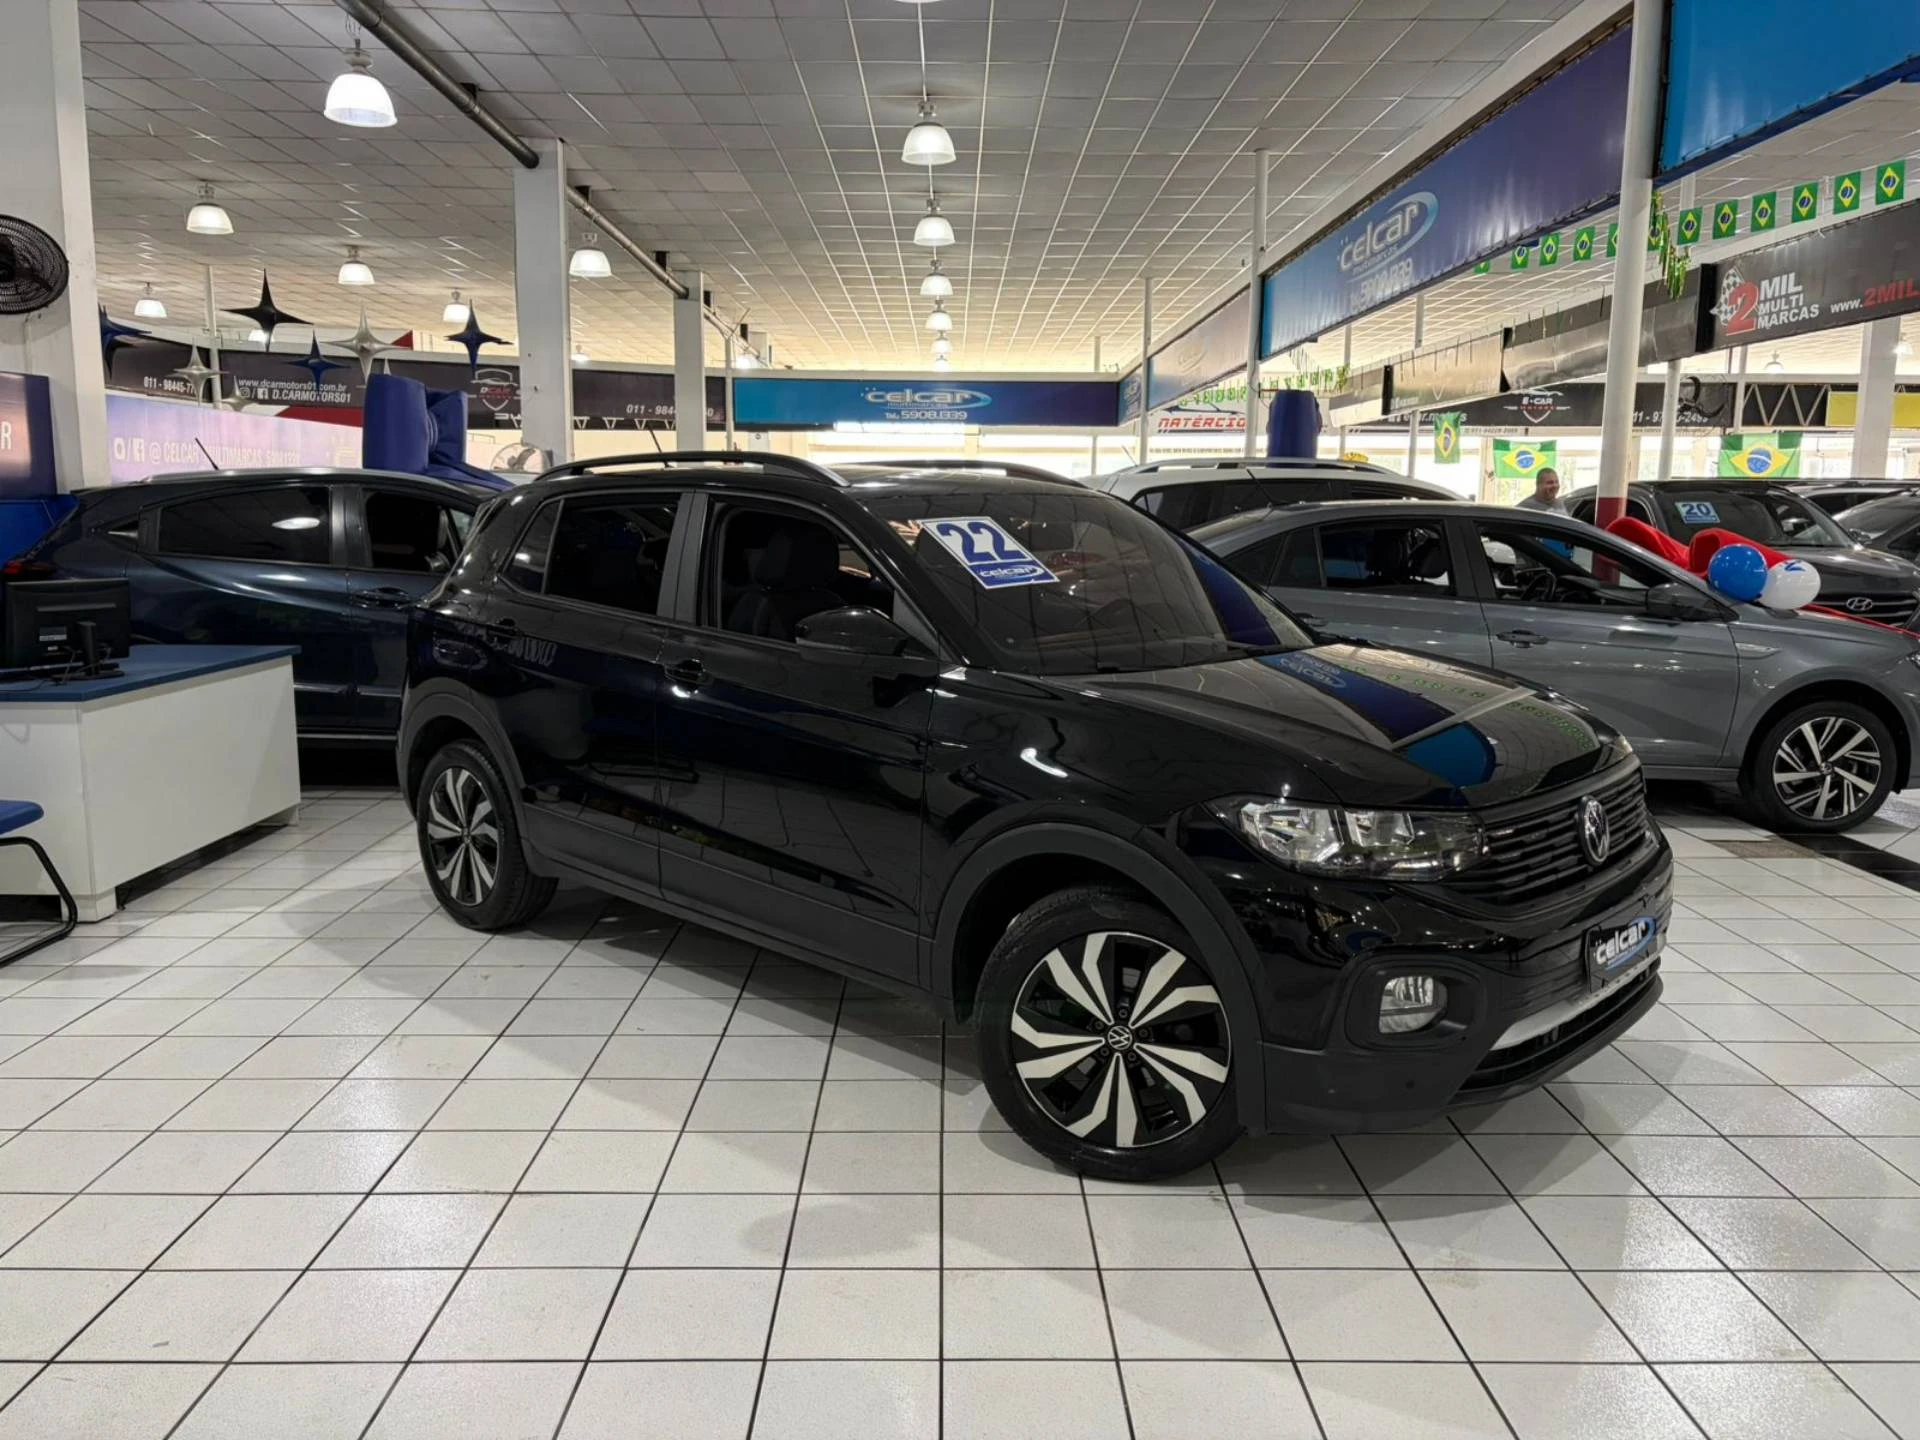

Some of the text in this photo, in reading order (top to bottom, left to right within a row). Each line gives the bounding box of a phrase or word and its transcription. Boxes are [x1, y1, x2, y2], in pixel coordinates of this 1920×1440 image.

[1338, 203, 1419, 272] celcar
[1760, 272, 1803, 299] MIL
[1726, 279, 1760, 336] 2
[1757, 304, 1820, 330] MARCAS
[1758, 293, 1804, 316] MULTI
[866, 388, 972, 404] celcar
[626, 404, 645, 415] 011
[1681, 503, 1712, 516] 20
[937, 522, 1028, 563] 22
[979, 565, 1034, 578] celcar
[1596, 919, 1647, 965] celcar
